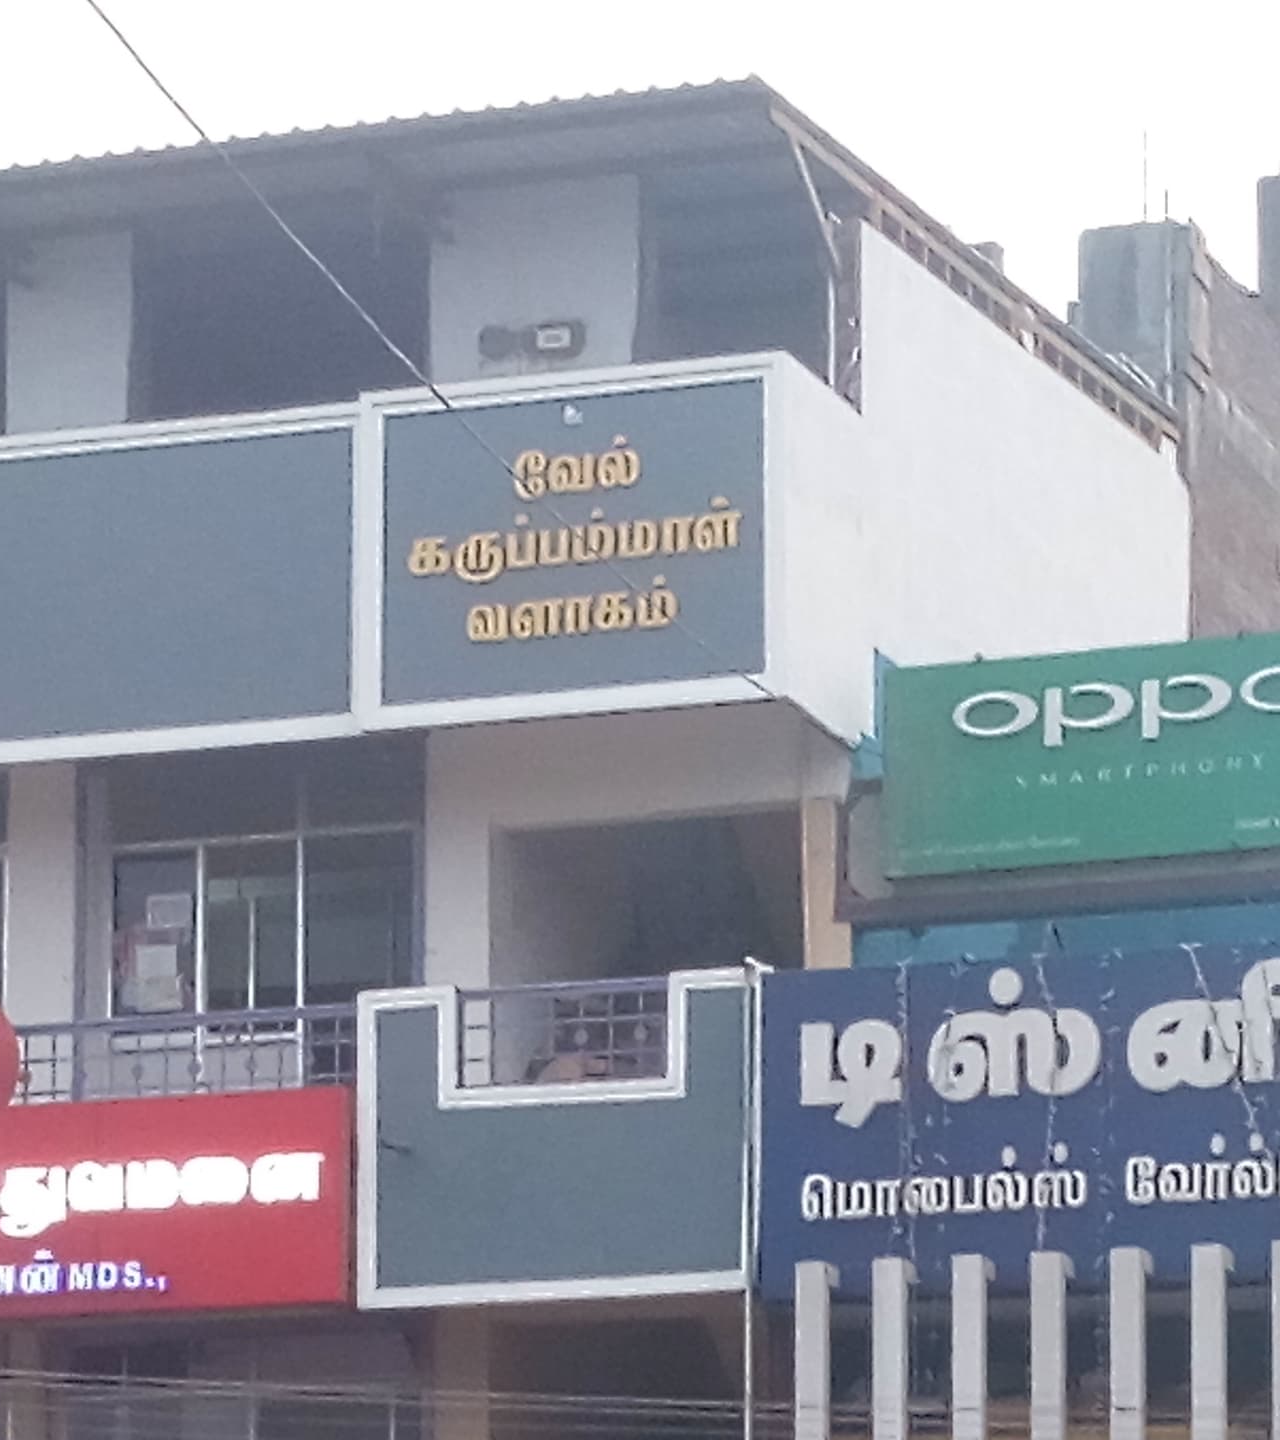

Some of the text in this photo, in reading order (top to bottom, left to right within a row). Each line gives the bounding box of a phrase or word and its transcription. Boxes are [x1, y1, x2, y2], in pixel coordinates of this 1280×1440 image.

[513, 434, 642, 500] வேல்
[407, 495, 743, 583] கருப்பம்மாள்
[466, 573, 679, 643] வளாகம்
[800, 1141, 1087, 1222] மொபைல்ஸ்
